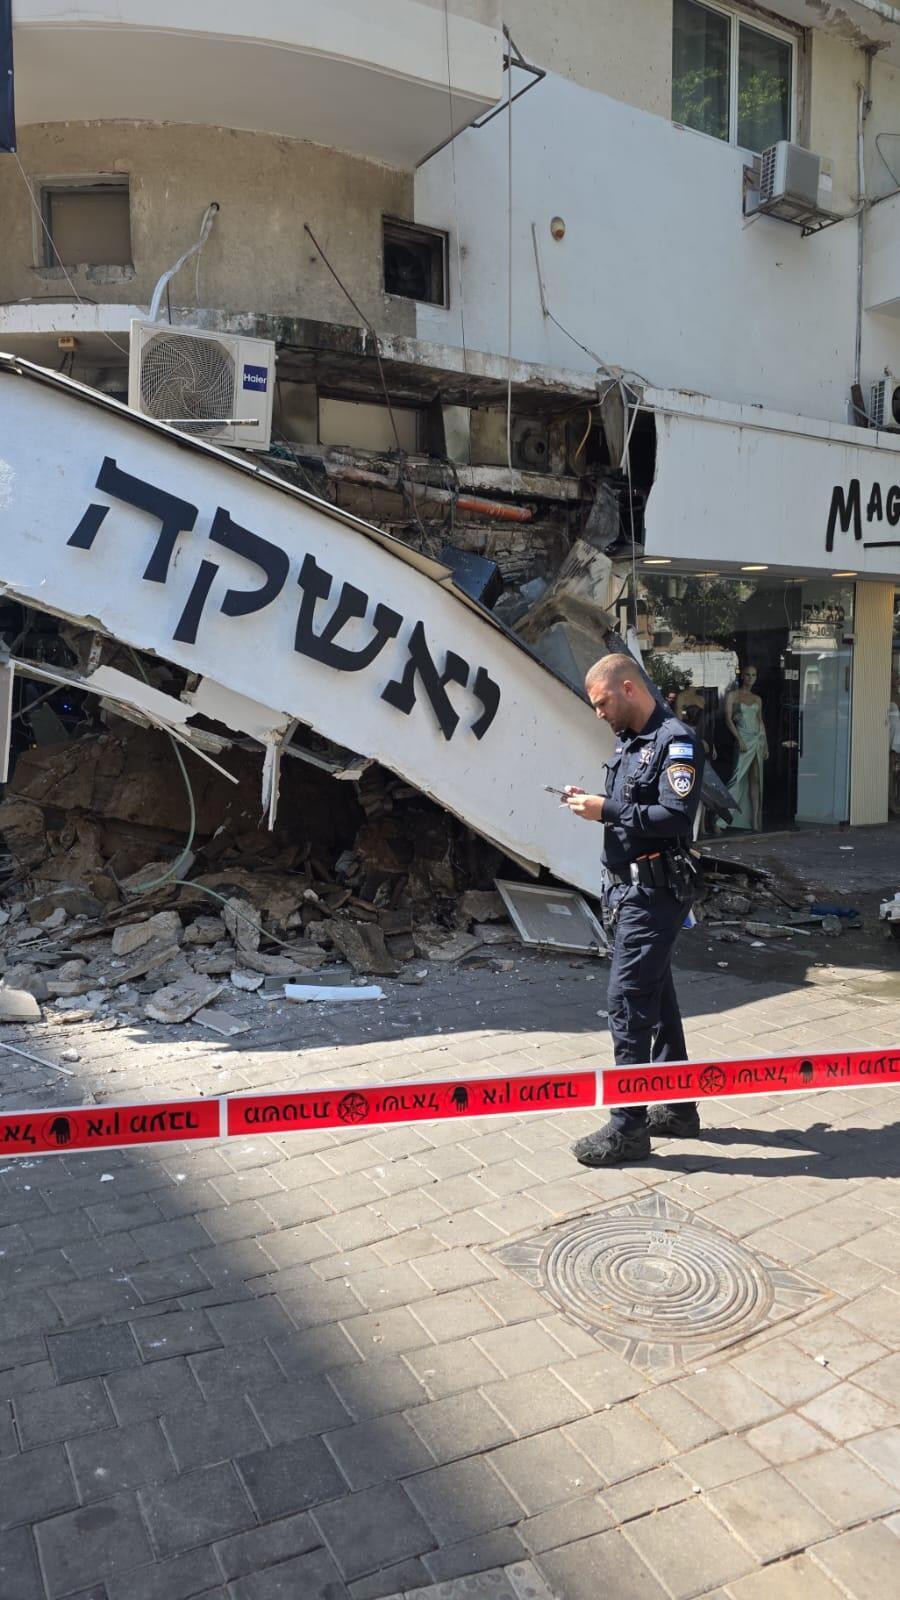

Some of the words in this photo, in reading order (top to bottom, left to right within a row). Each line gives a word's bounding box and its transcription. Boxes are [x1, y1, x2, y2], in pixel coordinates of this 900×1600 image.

[243, 373, 267, 384] Haier
[825, 478, 900, 552] MAG
[66, 456, 501, 742] יאשקה
[618, 1074, 692, 1092] משטרת
[733, 1065, 787, 1085] ישראל
[825, 1056, 852, 1079] אין
[243, 1102, 331, 1124] משטרת
[375, 1093, 440, 1111] ישראל
[483, 1080, 512, 1104] אין
[518, 1080, 578, 1101] מעבר
[86, 1110, 120, 1137] אין
[129, 1110, 199, 1134] מעבר
